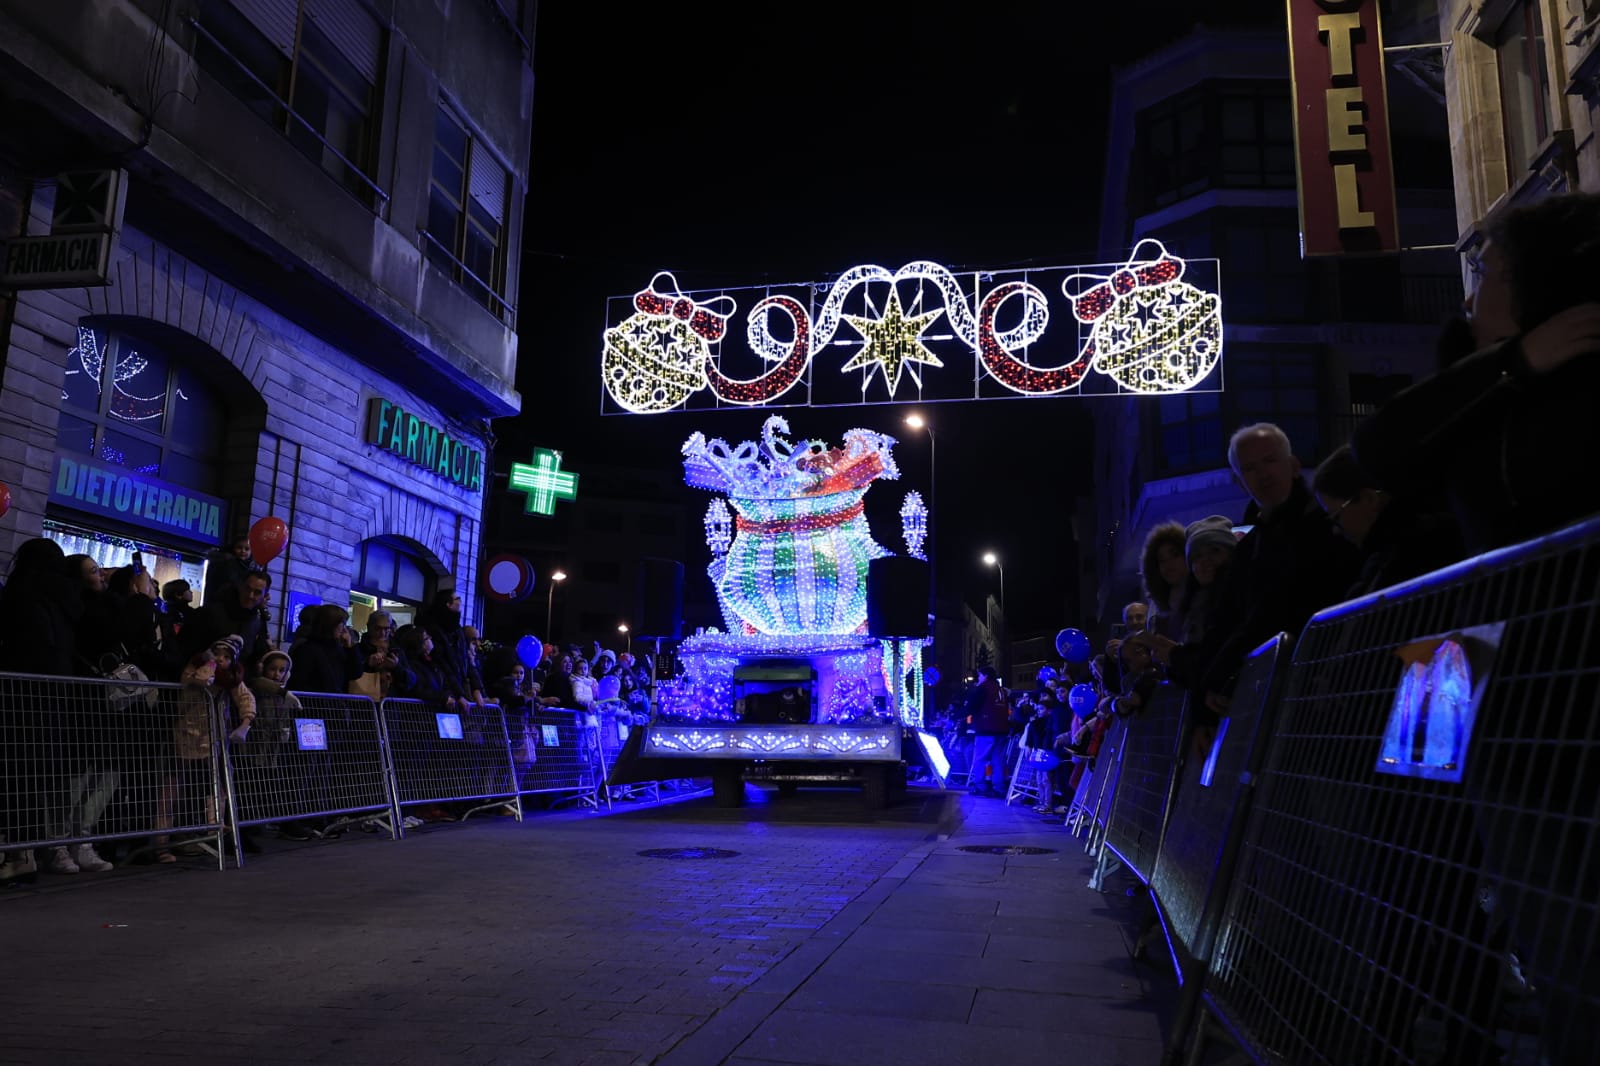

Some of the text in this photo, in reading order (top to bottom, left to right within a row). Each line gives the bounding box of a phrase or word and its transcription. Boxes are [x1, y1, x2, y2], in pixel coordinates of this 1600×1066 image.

[1318, 0, 1375, 228] TEL
[7, 239, 97, 274] FARMACIA
[377, 399, 481, 493] FARMACIA
[55, 457, 220, 538] DIETOTERAPIA
